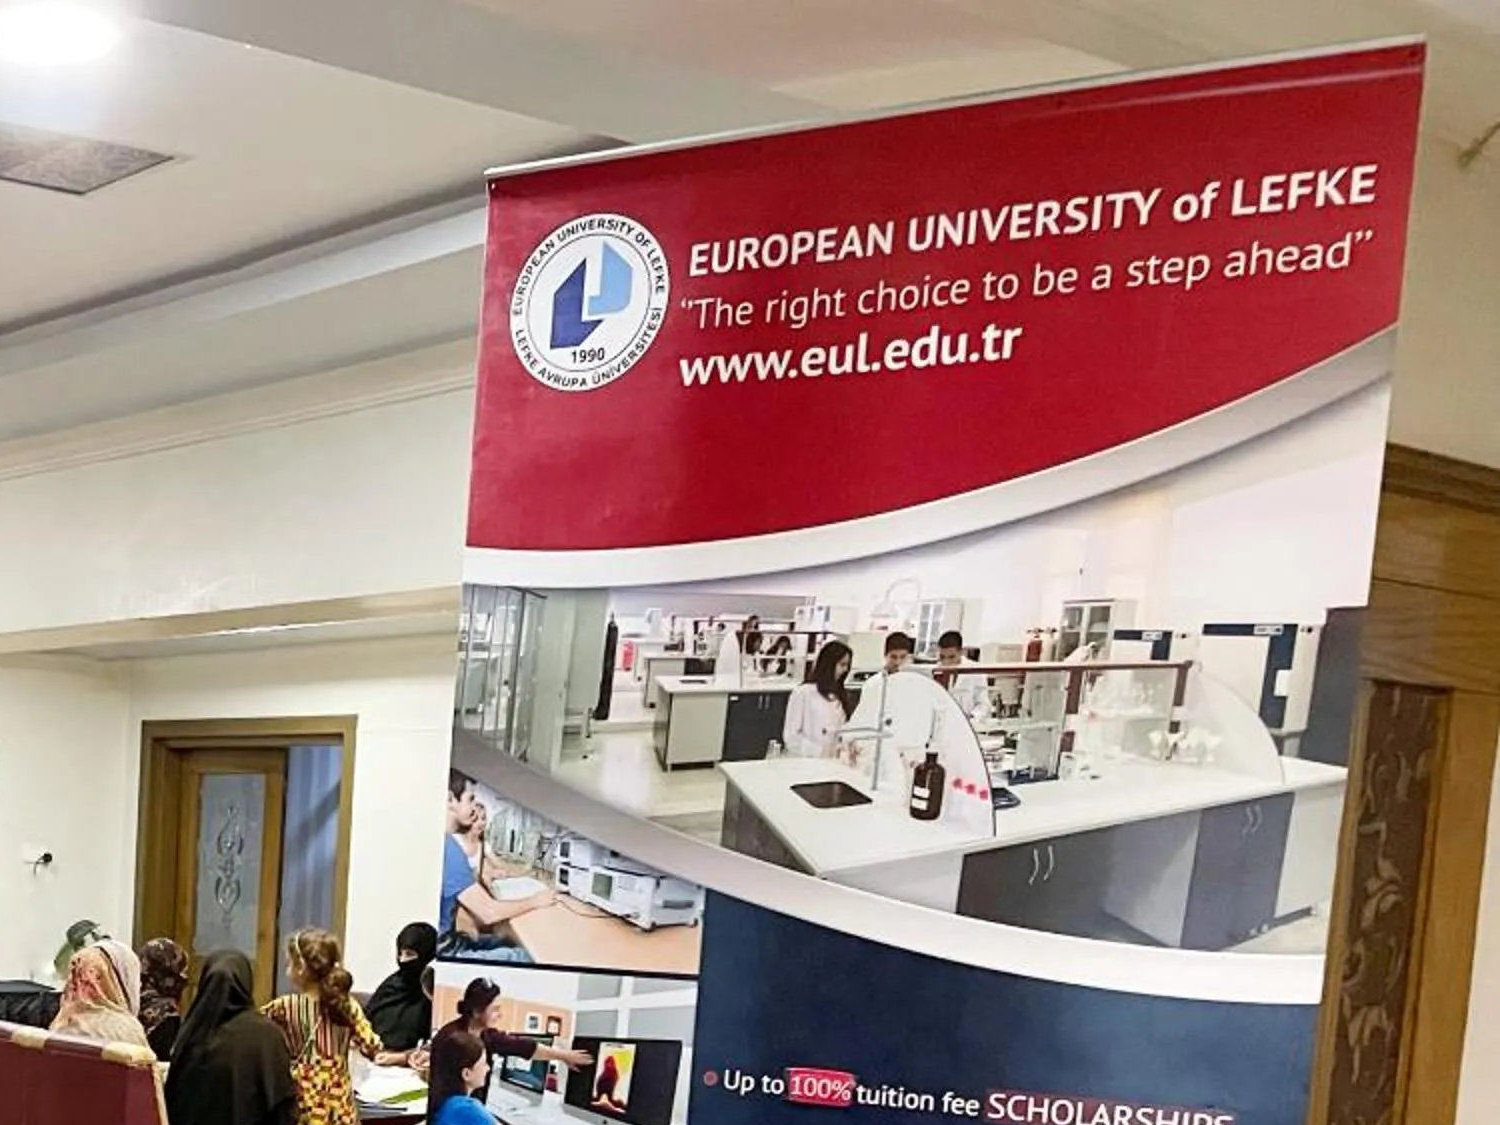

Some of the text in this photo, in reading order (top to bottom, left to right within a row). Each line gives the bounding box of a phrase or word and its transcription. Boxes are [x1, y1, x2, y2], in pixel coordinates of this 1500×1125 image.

[689, 164, 1378, 276] EUROPEAN UNIVERSITY of LEFKE
[512, 238, 556, 316] EUROPEAN
[635, 231, 651, 249] OF
[646, 247, 665, 295] LEFKE
[765, 288, 845, 328] right
[857, 275, 971, 315] choice
[982, 271, 1019, 300] to
[1033, 263, 1078, 296] be
[1091, 263, 1112, 290] a
[1126, 253, 1210, 290] step
[572, 348, 605, 364] 1990
[679, 323, 1022, 387] www.eul.edu.tr
[723, 1069, 755, 1096] Up
[761, 1074, 784, 1095] to
[789, 1074, 852, 1102] 100%
[856, 1082, 934, 1113] tuition
[942, 1091, 980, 1117] fee
